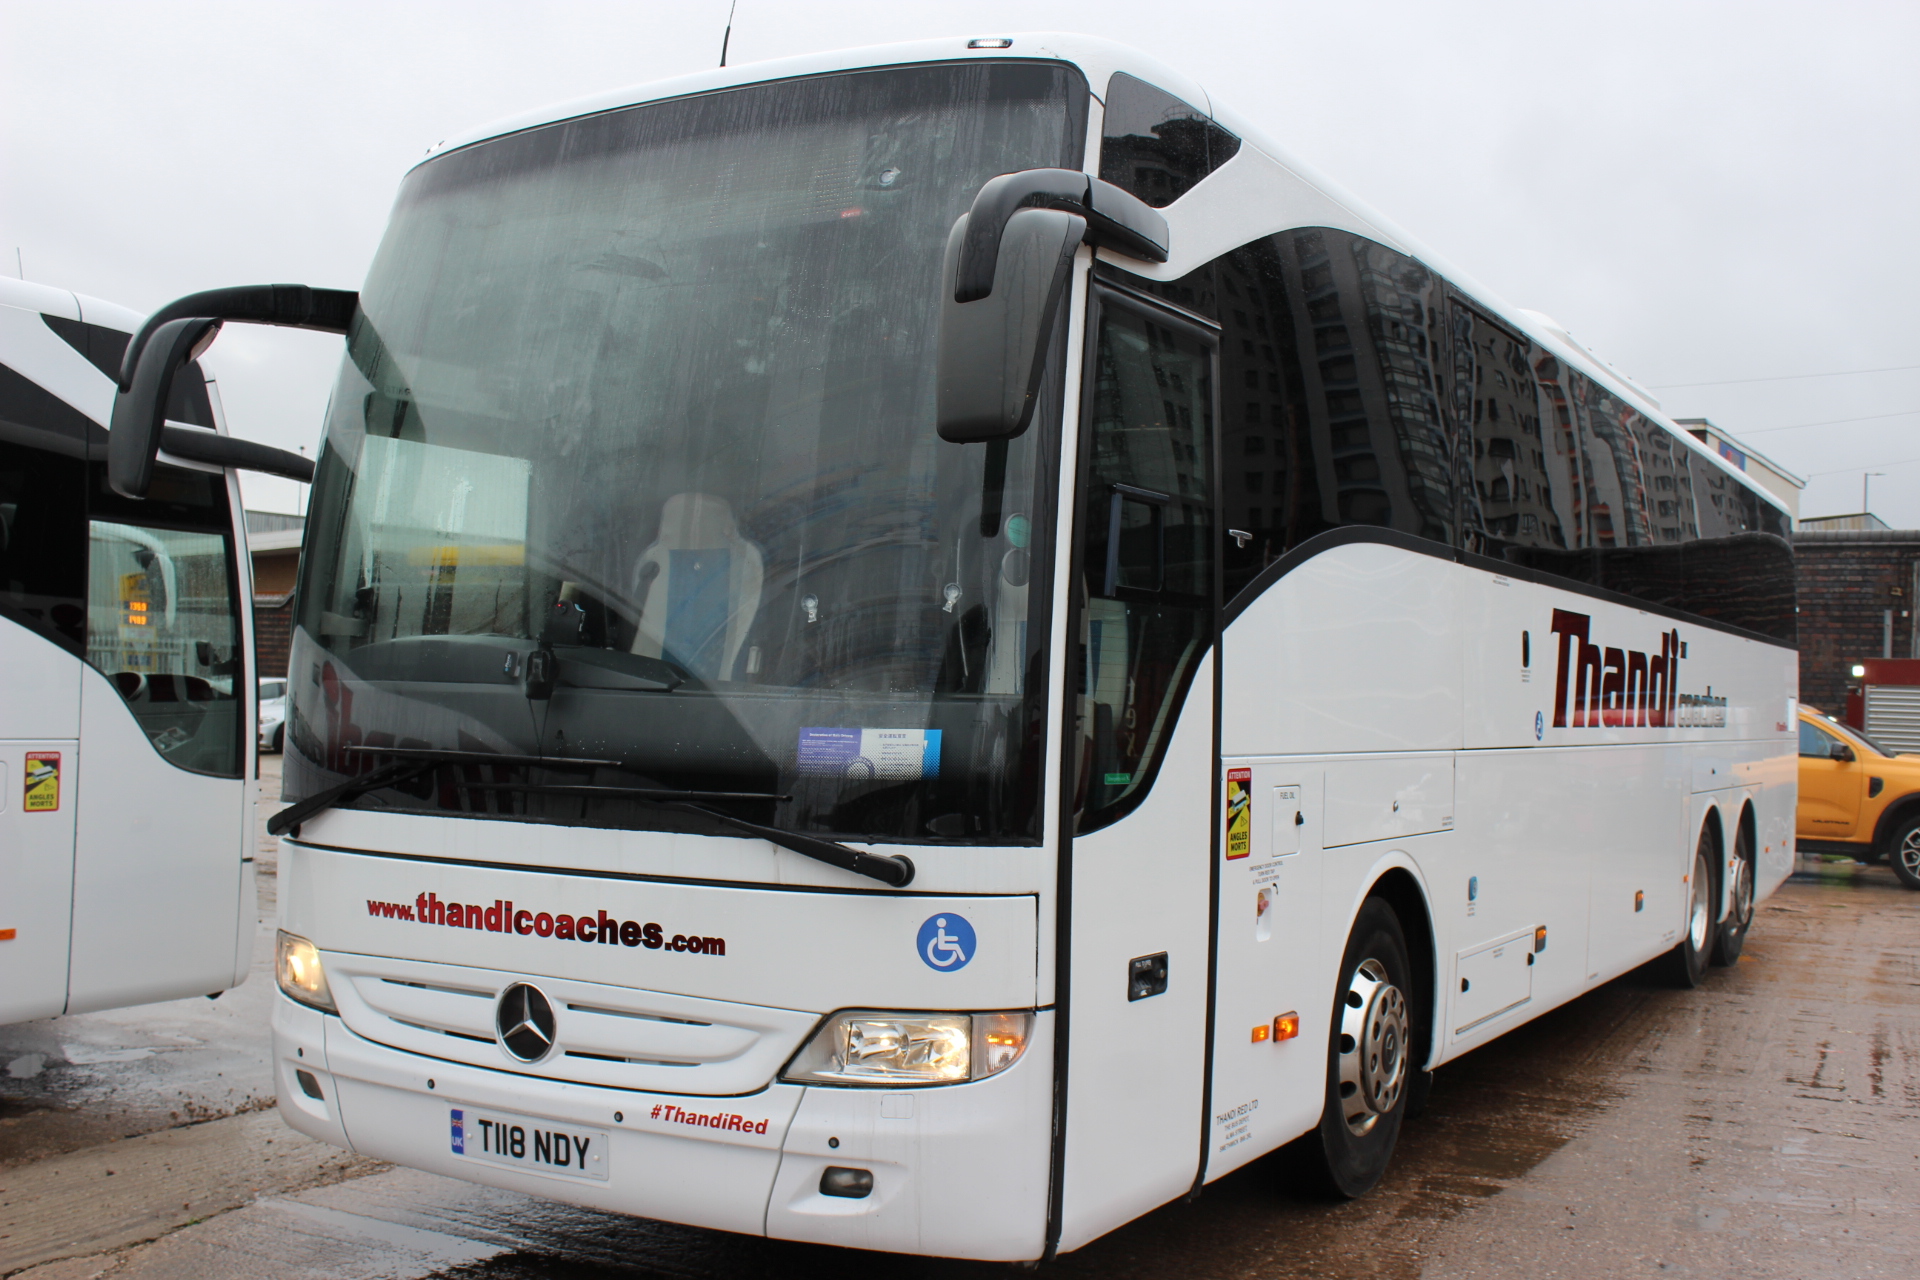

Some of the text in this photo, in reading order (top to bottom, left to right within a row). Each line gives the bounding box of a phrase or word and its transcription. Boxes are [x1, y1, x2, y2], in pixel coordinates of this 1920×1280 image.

[1551, 608, 1679, 728] Thandi
[1229, 771, 1251, 780] ATTENTION
[1280, 792, 1289, 800] FUEL
[1230, 832, 1248, 842] ANGLES
[1231, 842, 1246, 852] MORTS
[366, 892, 726, 956] www.thandicoaches.com
[650, 1104, 769, 1136] #ThandiRed
[1216, 1099, 1259, 1125] THANDI RED LTD
[451, 1136, 463, 1147] UK
[478, 1119, 590, 1170] T118 NDY
